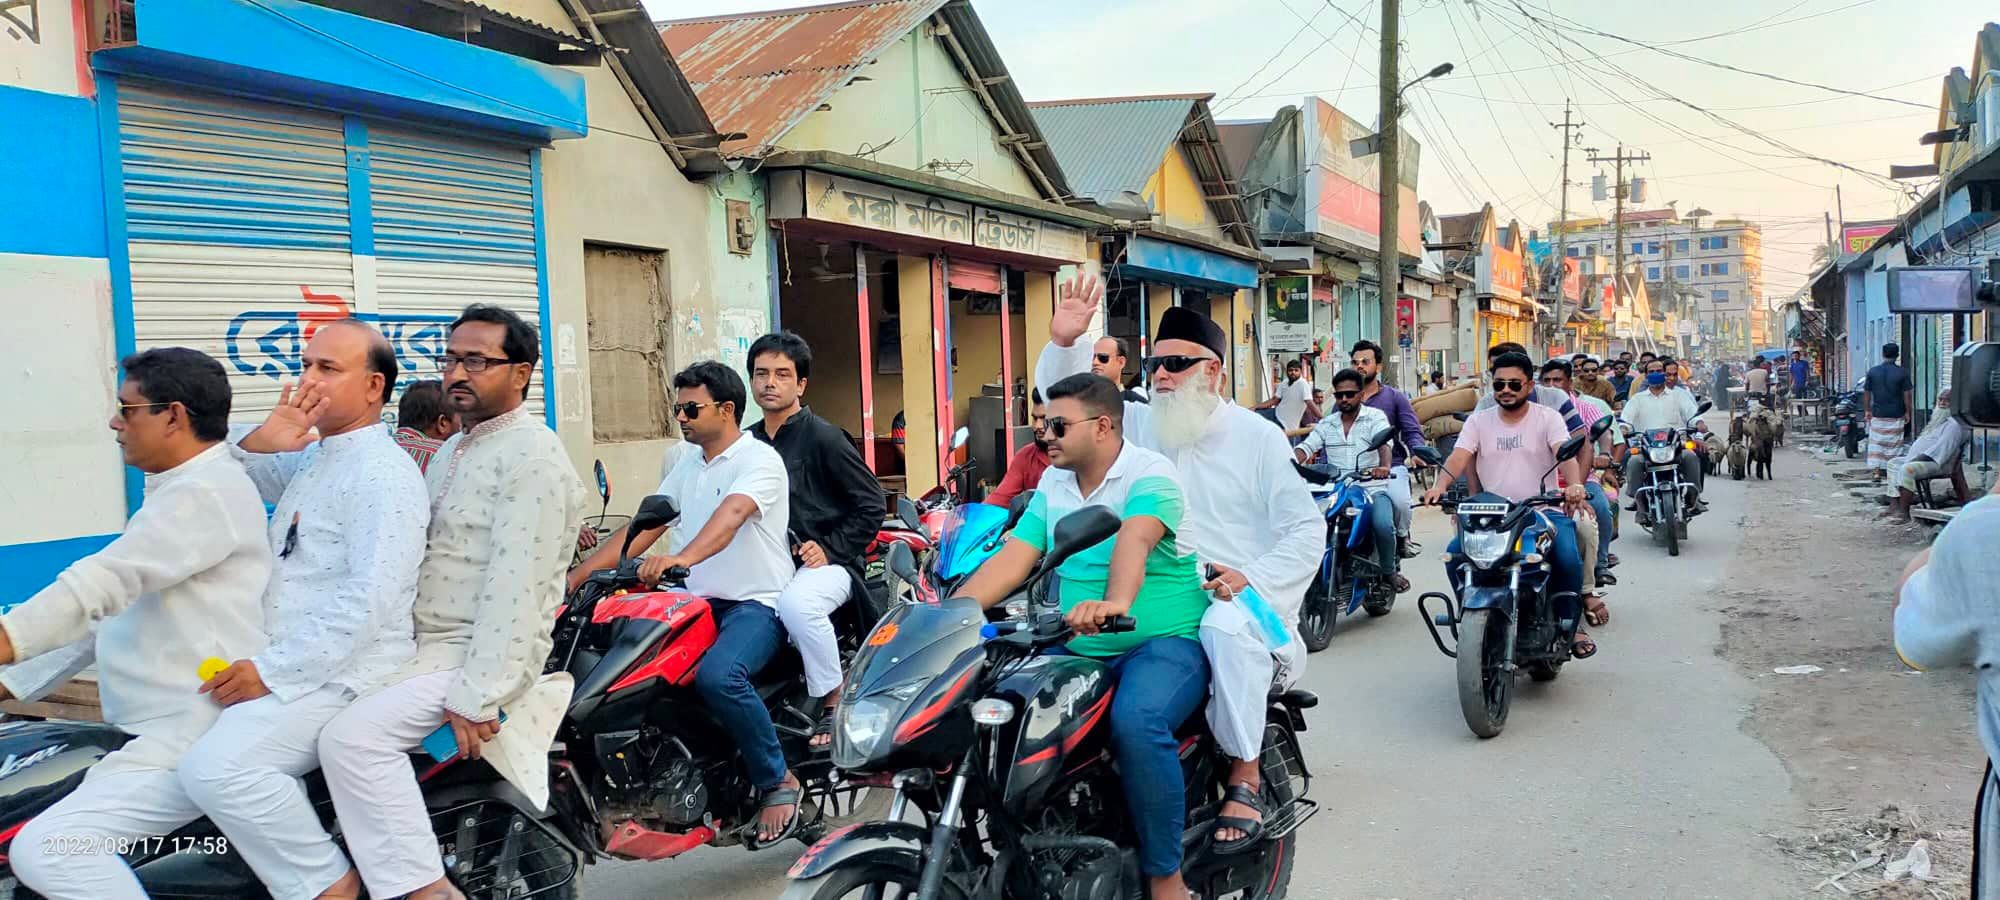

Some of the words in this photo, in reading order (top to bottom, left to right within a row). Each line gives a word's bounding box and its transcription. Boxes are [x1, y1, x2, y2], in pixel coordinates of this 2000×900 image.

[842, 189, 898, 229] মক্কা
[905, 197, 970, 241] মদিনা
[976, 209, 1035, 250] ট্রেডার্স
